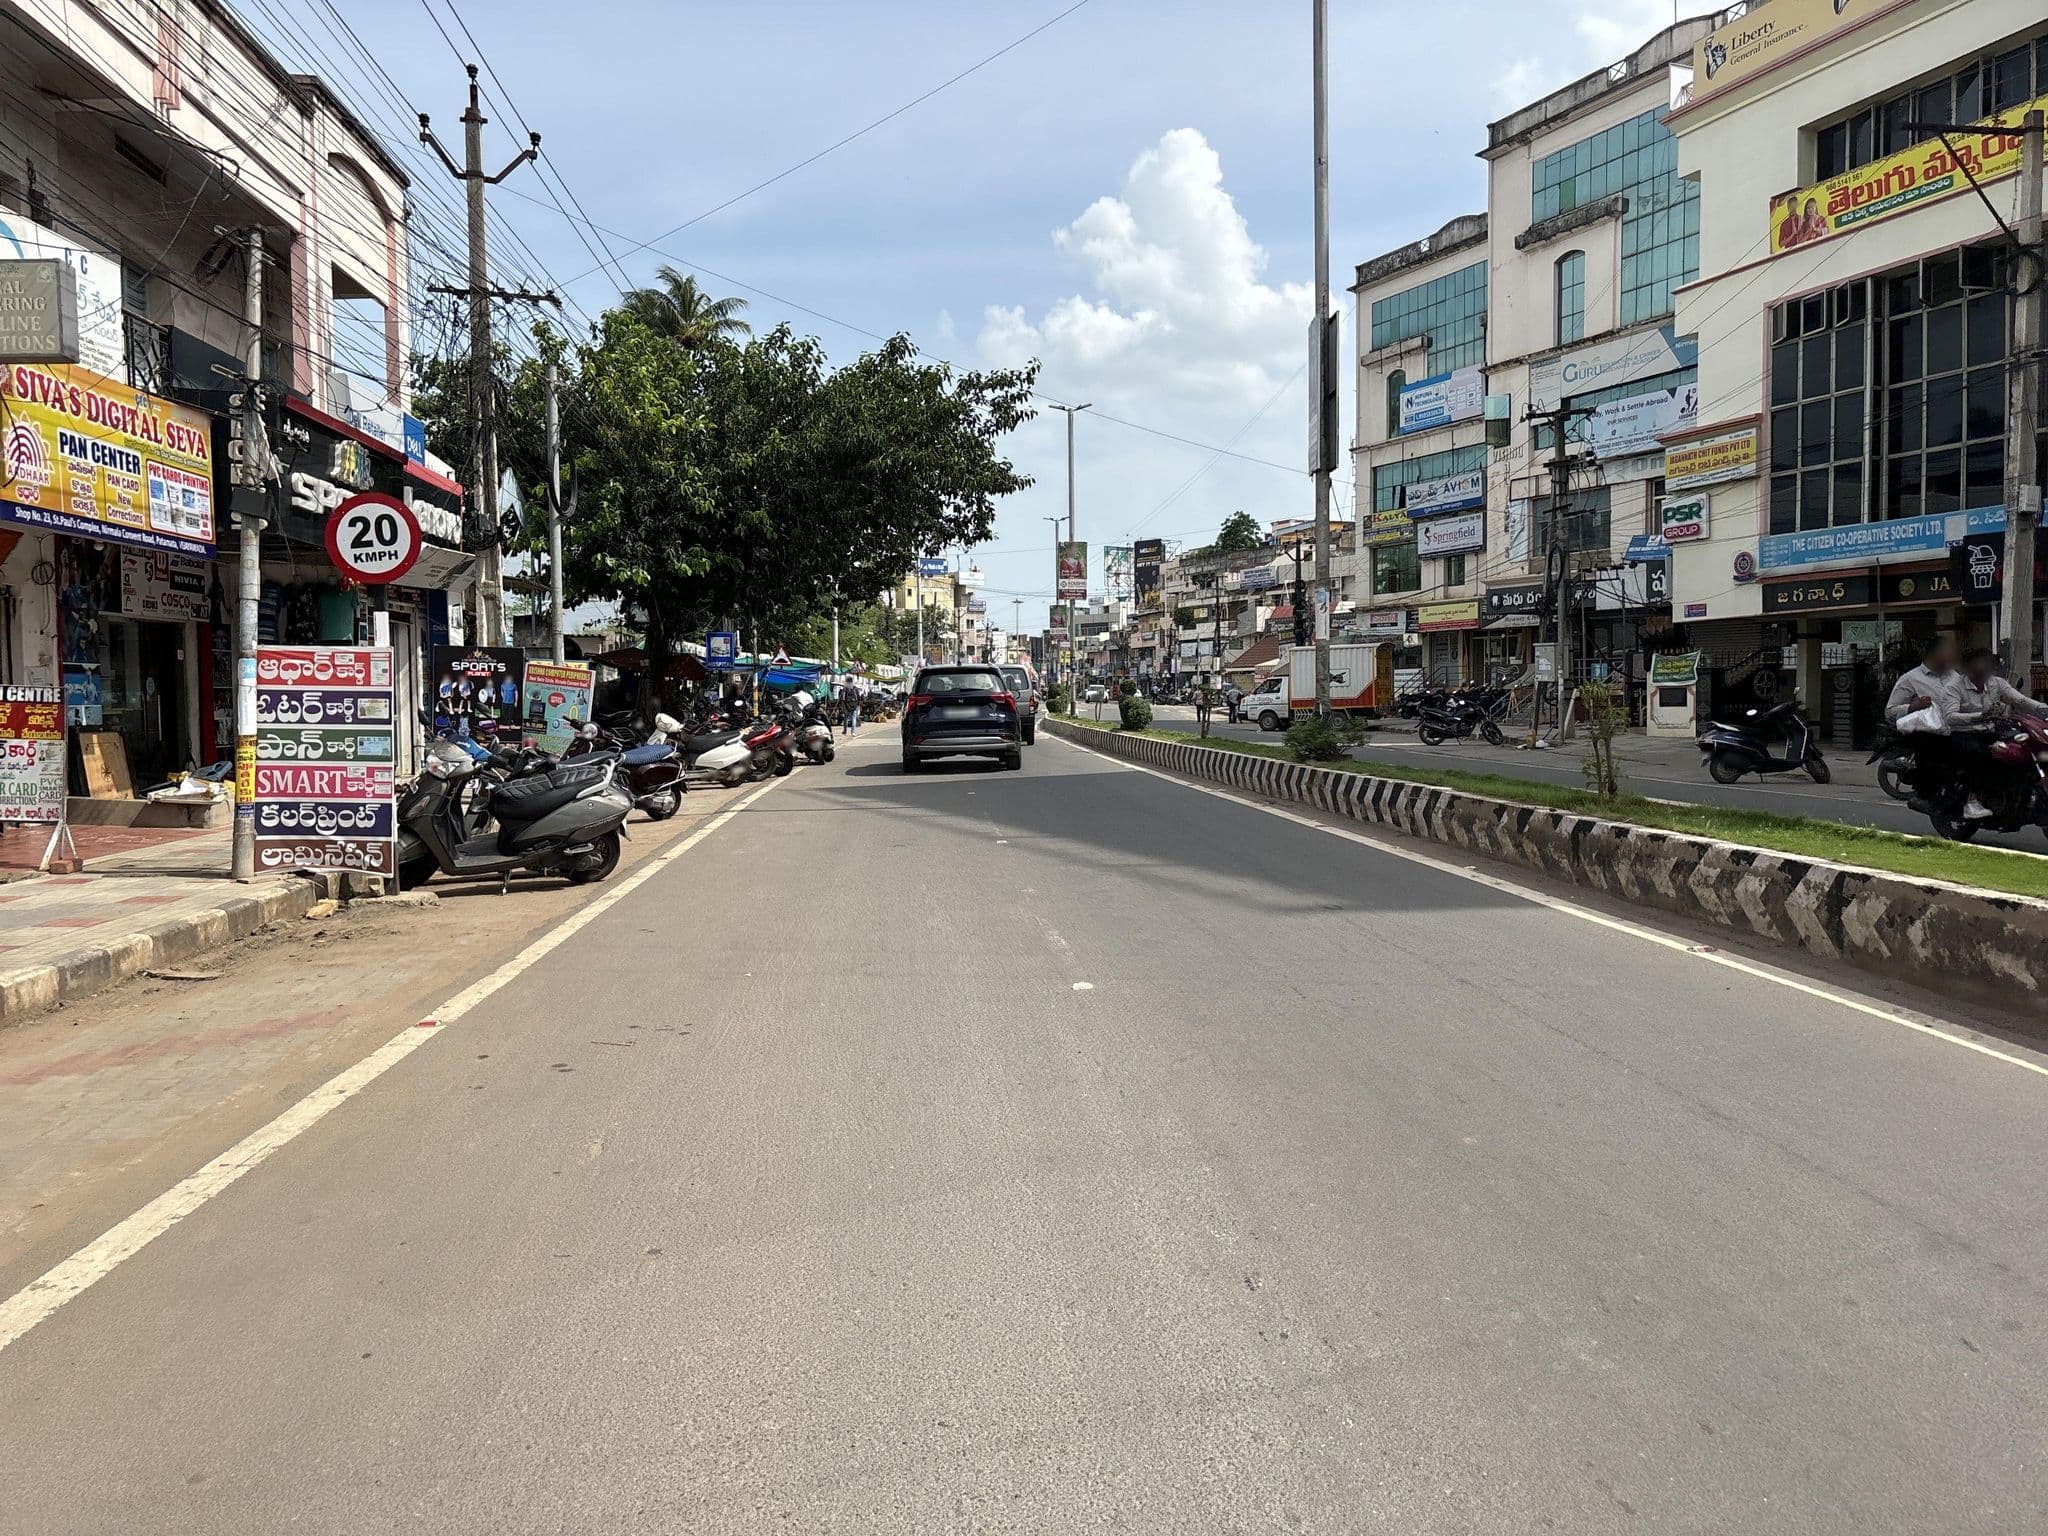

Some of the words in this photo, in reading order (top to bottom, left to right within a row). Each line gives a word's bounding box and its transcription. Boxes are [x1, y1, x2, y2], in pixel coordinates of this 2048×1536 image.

[1730, 43, 1761, 66] General
[1764, 24, 1804, 49] Insurance
[1731, 20, 1777, 51] Liberty
[1828, 165, 1915, 215] తెలుగు
[16, 366, 81, 417] SIVA'S
[87, 391, 163, 445] DIGITAL
[166, 421, 208, 460] SEVA
[1604, 407, 1620, 416] Work
[1627, 402, 1645, 410] Settle
[1645, 396, 1668, 407] Abroad
[59, 431, 88, 461] PAN
[91, 442, 141, 475] CENTER
[407, 435, 423, 458] DELL
[1698, 448, 1711, 459] CHIT
[1711, 444, 1729, 456] FUNDS
[1730, 441, 1739, 452] PVT
[1740, 439, 1751, 449] LTD
[8, 464, 49, 483] AADHAAR
[107, 473, 120, 487] PAN
[122, 478, 140, 492] CARD
[149, 463, 161, 478] PVC
[162, 467, 182, 484] CARDS
[183, 473, 208, 492] PRINTING
[117, 491, 132, 506] New
[15, 506, 31, 522] Shop
[32, 509, 42, 521] No.
[107, 505, 143, 524] Corrections
[1662, 502, 1704, 525] PSR
[348, 513, 399, 549] 20
[1432, 525, 1476, 545] Springfield
[1665, 525, 1698, 538] GROUP
[1792, 539, 1806, 552] THE
[1807, 535, 1834, 551] CITIZEN
[1836, 526, 1889, 547] CO-OPERATIVE
[1891, 520, 1924, 540] SOCIETY
[1926, 519, 1943, 534] LTD.
[353, 550, 399, 563] KMPH
[174, 574, 199, 586] NIVIA
[161, 592, 191, 609] COSCO
[257, 651, 334, 685] ఆధార్
[336, 662, 366, 685] కార్డ్
[451, 661, 507, 673] SPORTS
[7, 686, 61, 702] CENTRE
[257, 691, 323, 723] ఓటర్
[326, 698, 356, 723] కార్డ్
[9, 741, 37, 766] కార్డ్
[257, 730, 323, 760] పాన్
[326, 737, 356, 760] కార్డ్
[9, 782, 37, 796] CARD
[40, 778, 62, 786] PVC
[257, 769, 347, 795] SMART
[346, 777, 376, 798] కార్డ్
[39, 791, 61, 799] CARD
[261, 840, 384, 870] లామినేషన్
